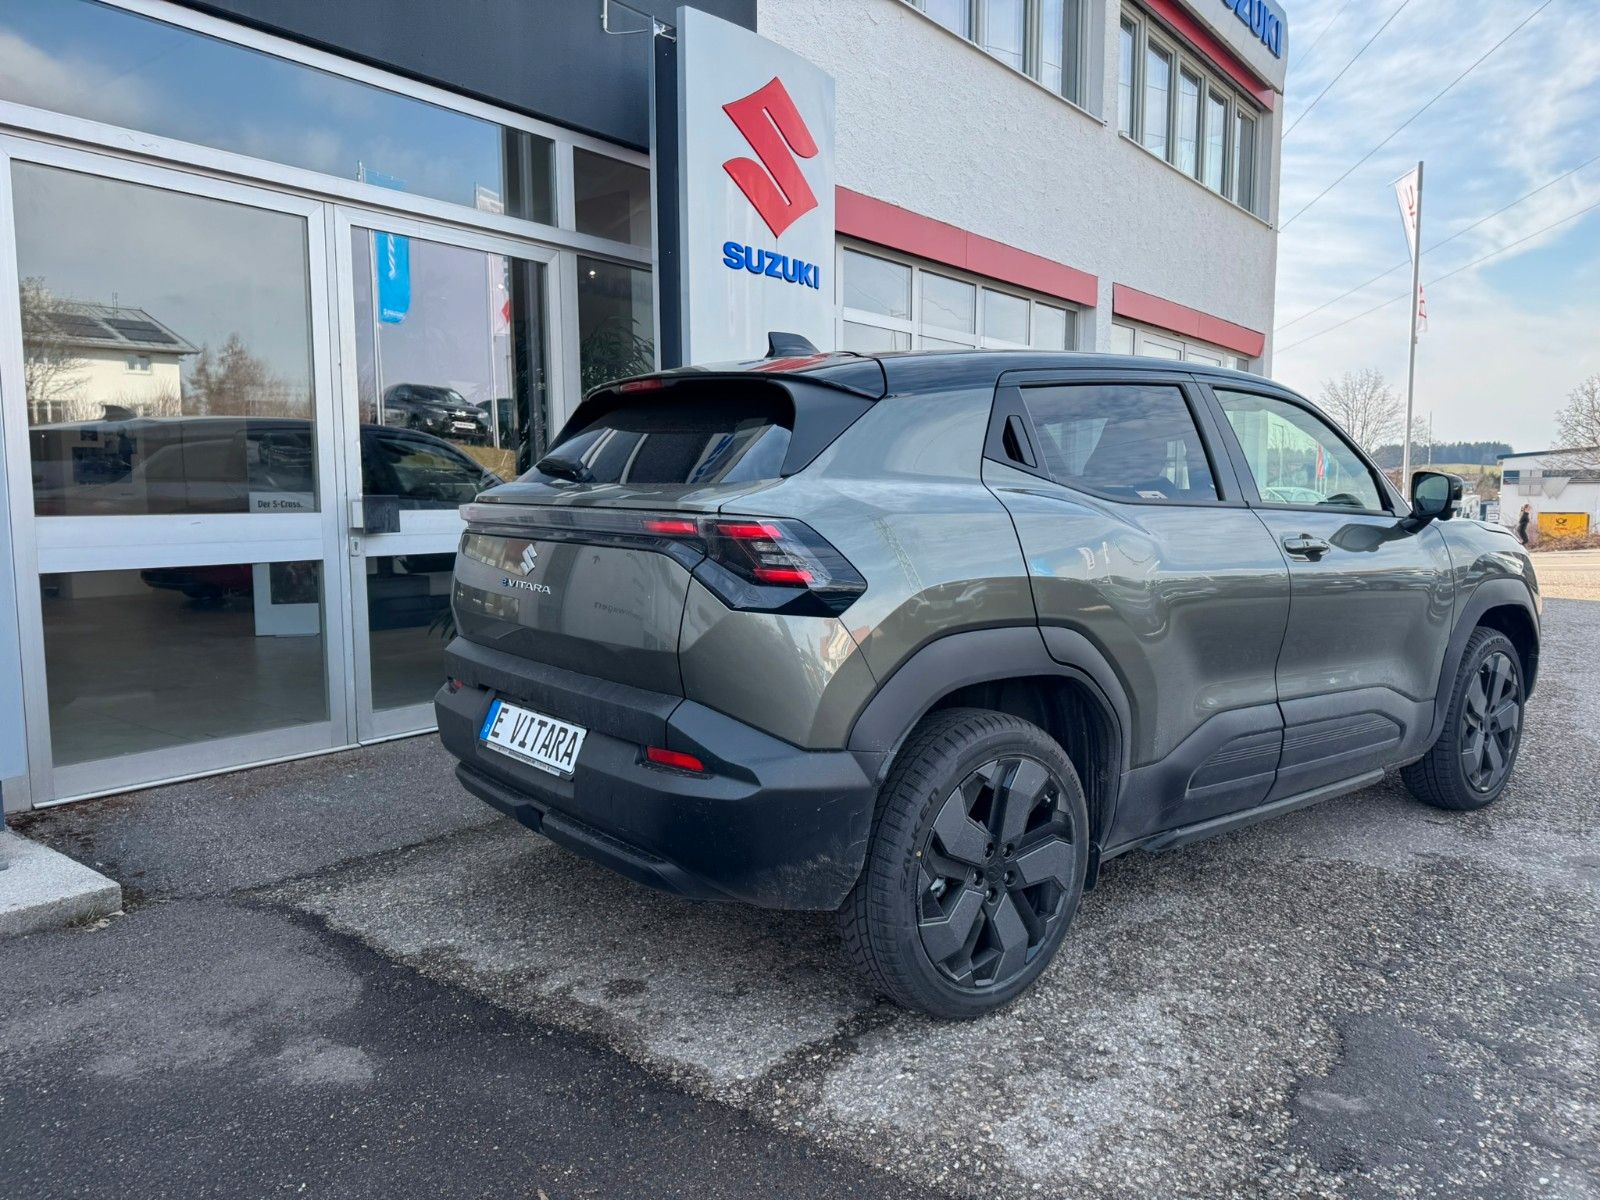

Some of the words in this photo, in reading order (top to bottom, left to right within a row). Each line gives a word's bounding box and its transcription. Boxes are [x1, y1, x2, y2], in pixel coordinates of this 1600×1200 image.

[722, 241, 819, 290] SUZUKI
[257, 500, 270, 508] Der
[272, 500, 304, 509] S-Cross.
[490, 707, 510, 739] E
[510, 712, 578, 767] VITARA
